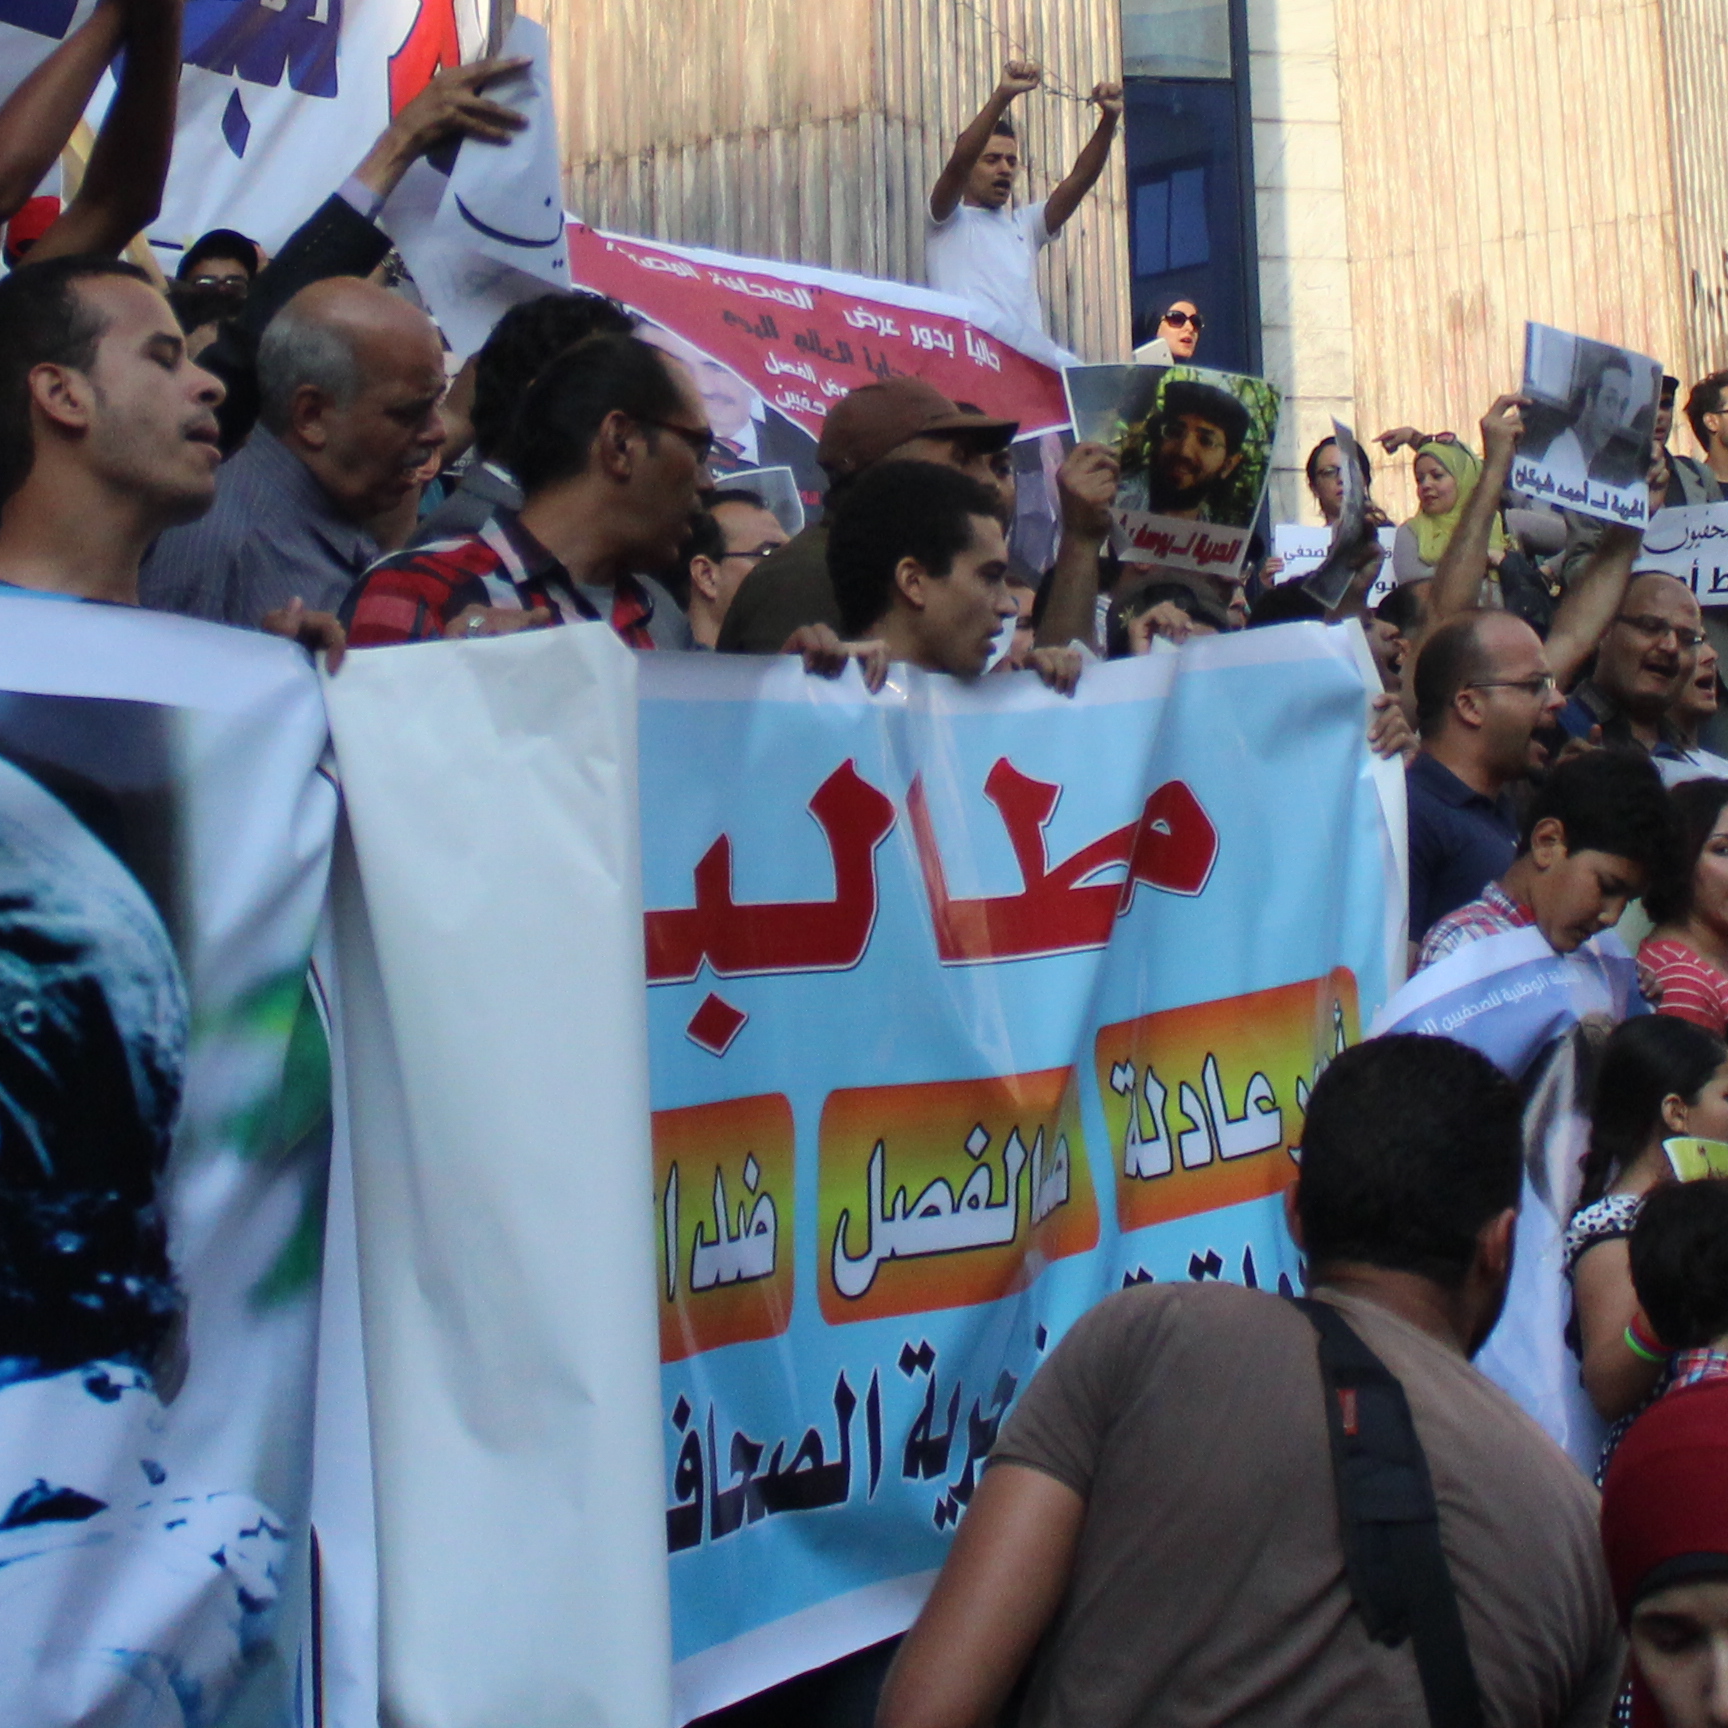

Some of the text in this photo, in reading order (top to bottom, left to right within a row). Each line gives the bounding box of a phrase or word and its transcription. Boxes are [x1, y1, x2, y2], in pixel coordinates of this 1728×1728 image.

[842, 305, 902, 338] عرض
[1109, 1051, 1284, 1183] عادلة
[832, 1122, 1044, 1301] الفصل
